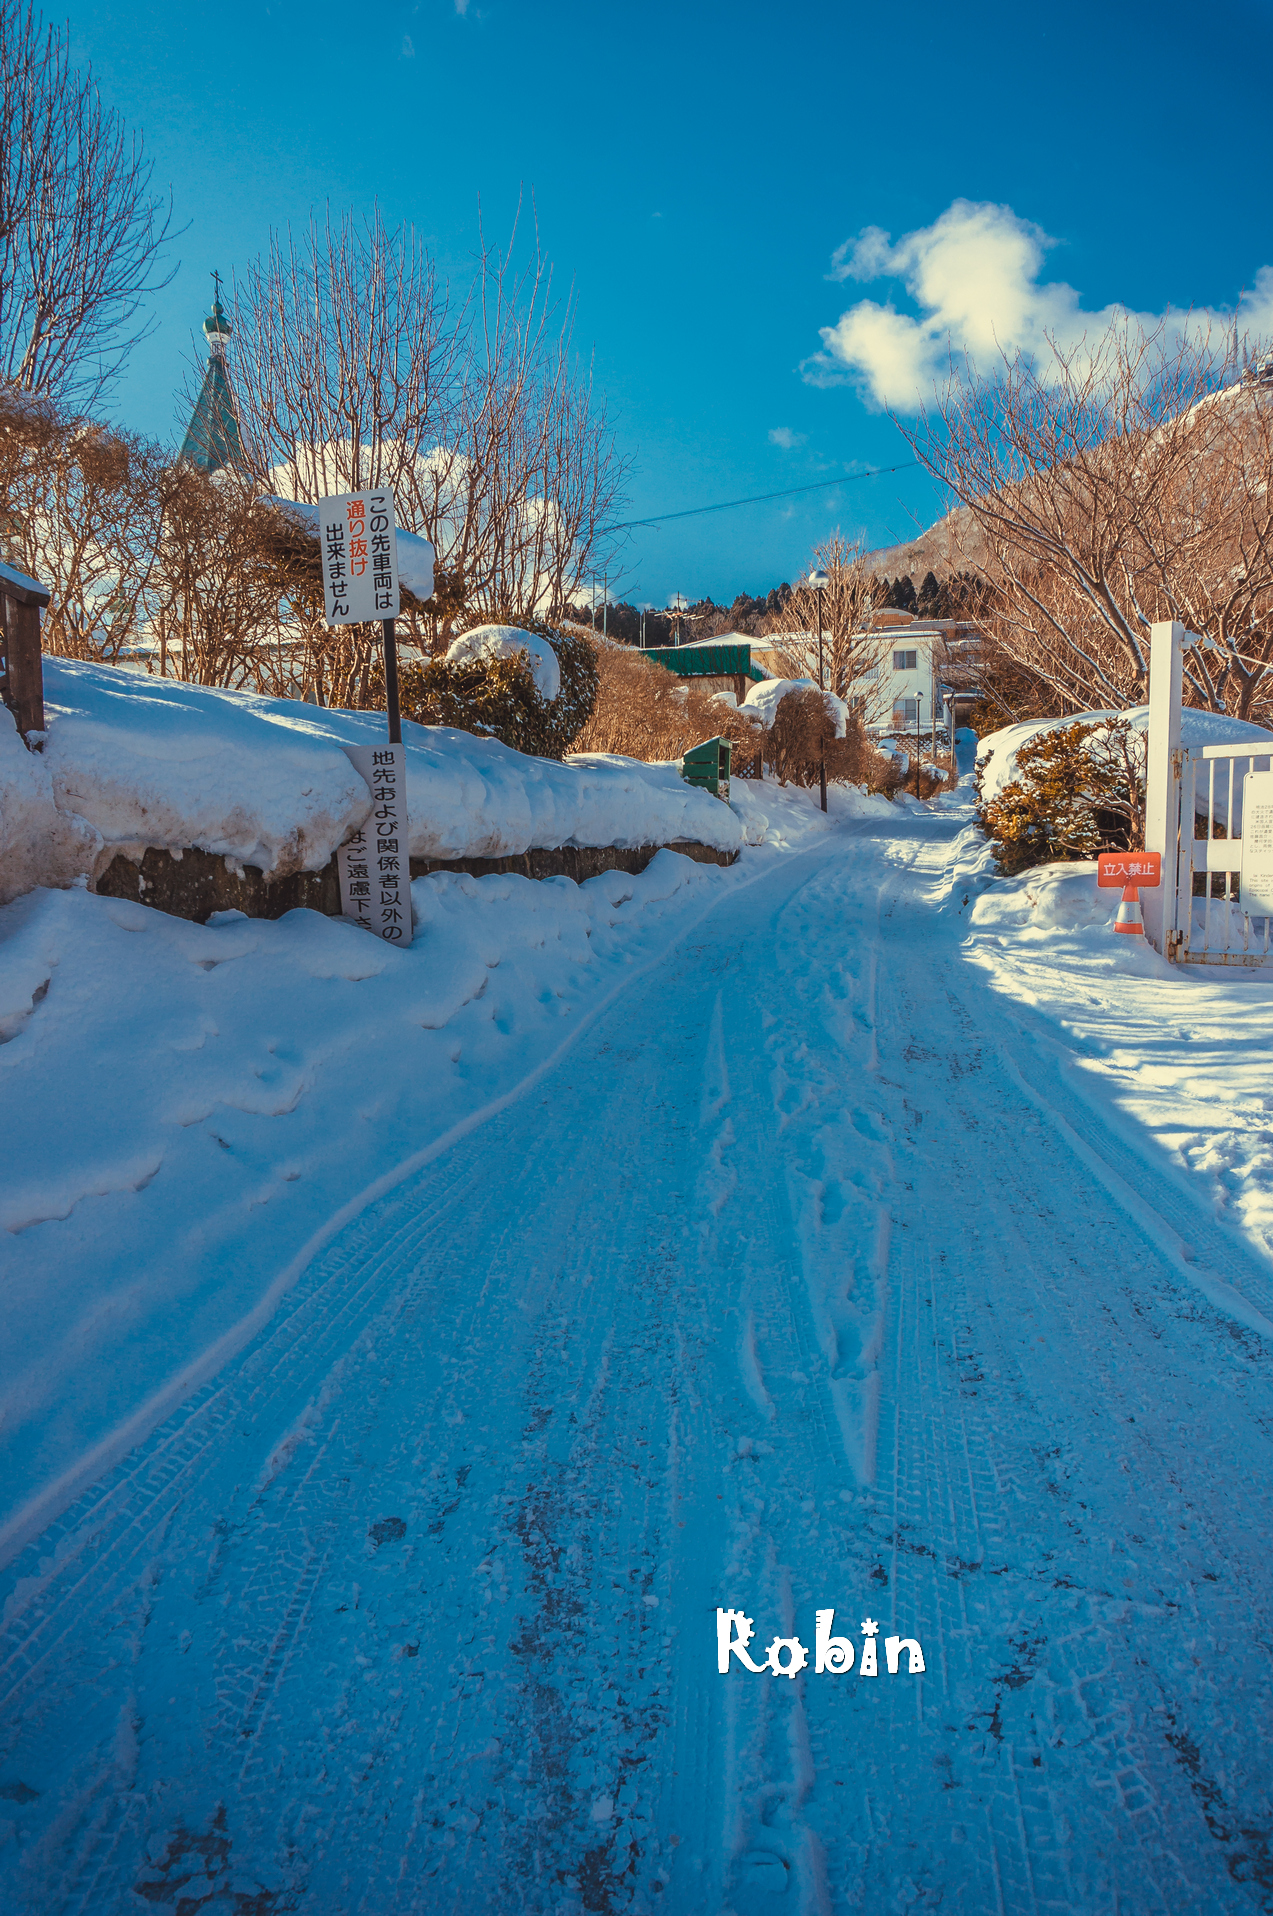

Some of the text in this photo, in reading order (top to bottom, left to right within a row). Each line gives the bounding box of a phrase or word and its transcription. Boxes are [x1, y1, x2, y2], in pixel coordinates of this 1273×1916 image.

[326, 523, 349, 618] 出来ません
[346, 499, 368, 576] 通り抜け
[370, 496, 393, 610] この先車両は
[372, 750, 402, 940] 地先および関係者以外の
[1103, 862, 1155, 876] 立入禁止
